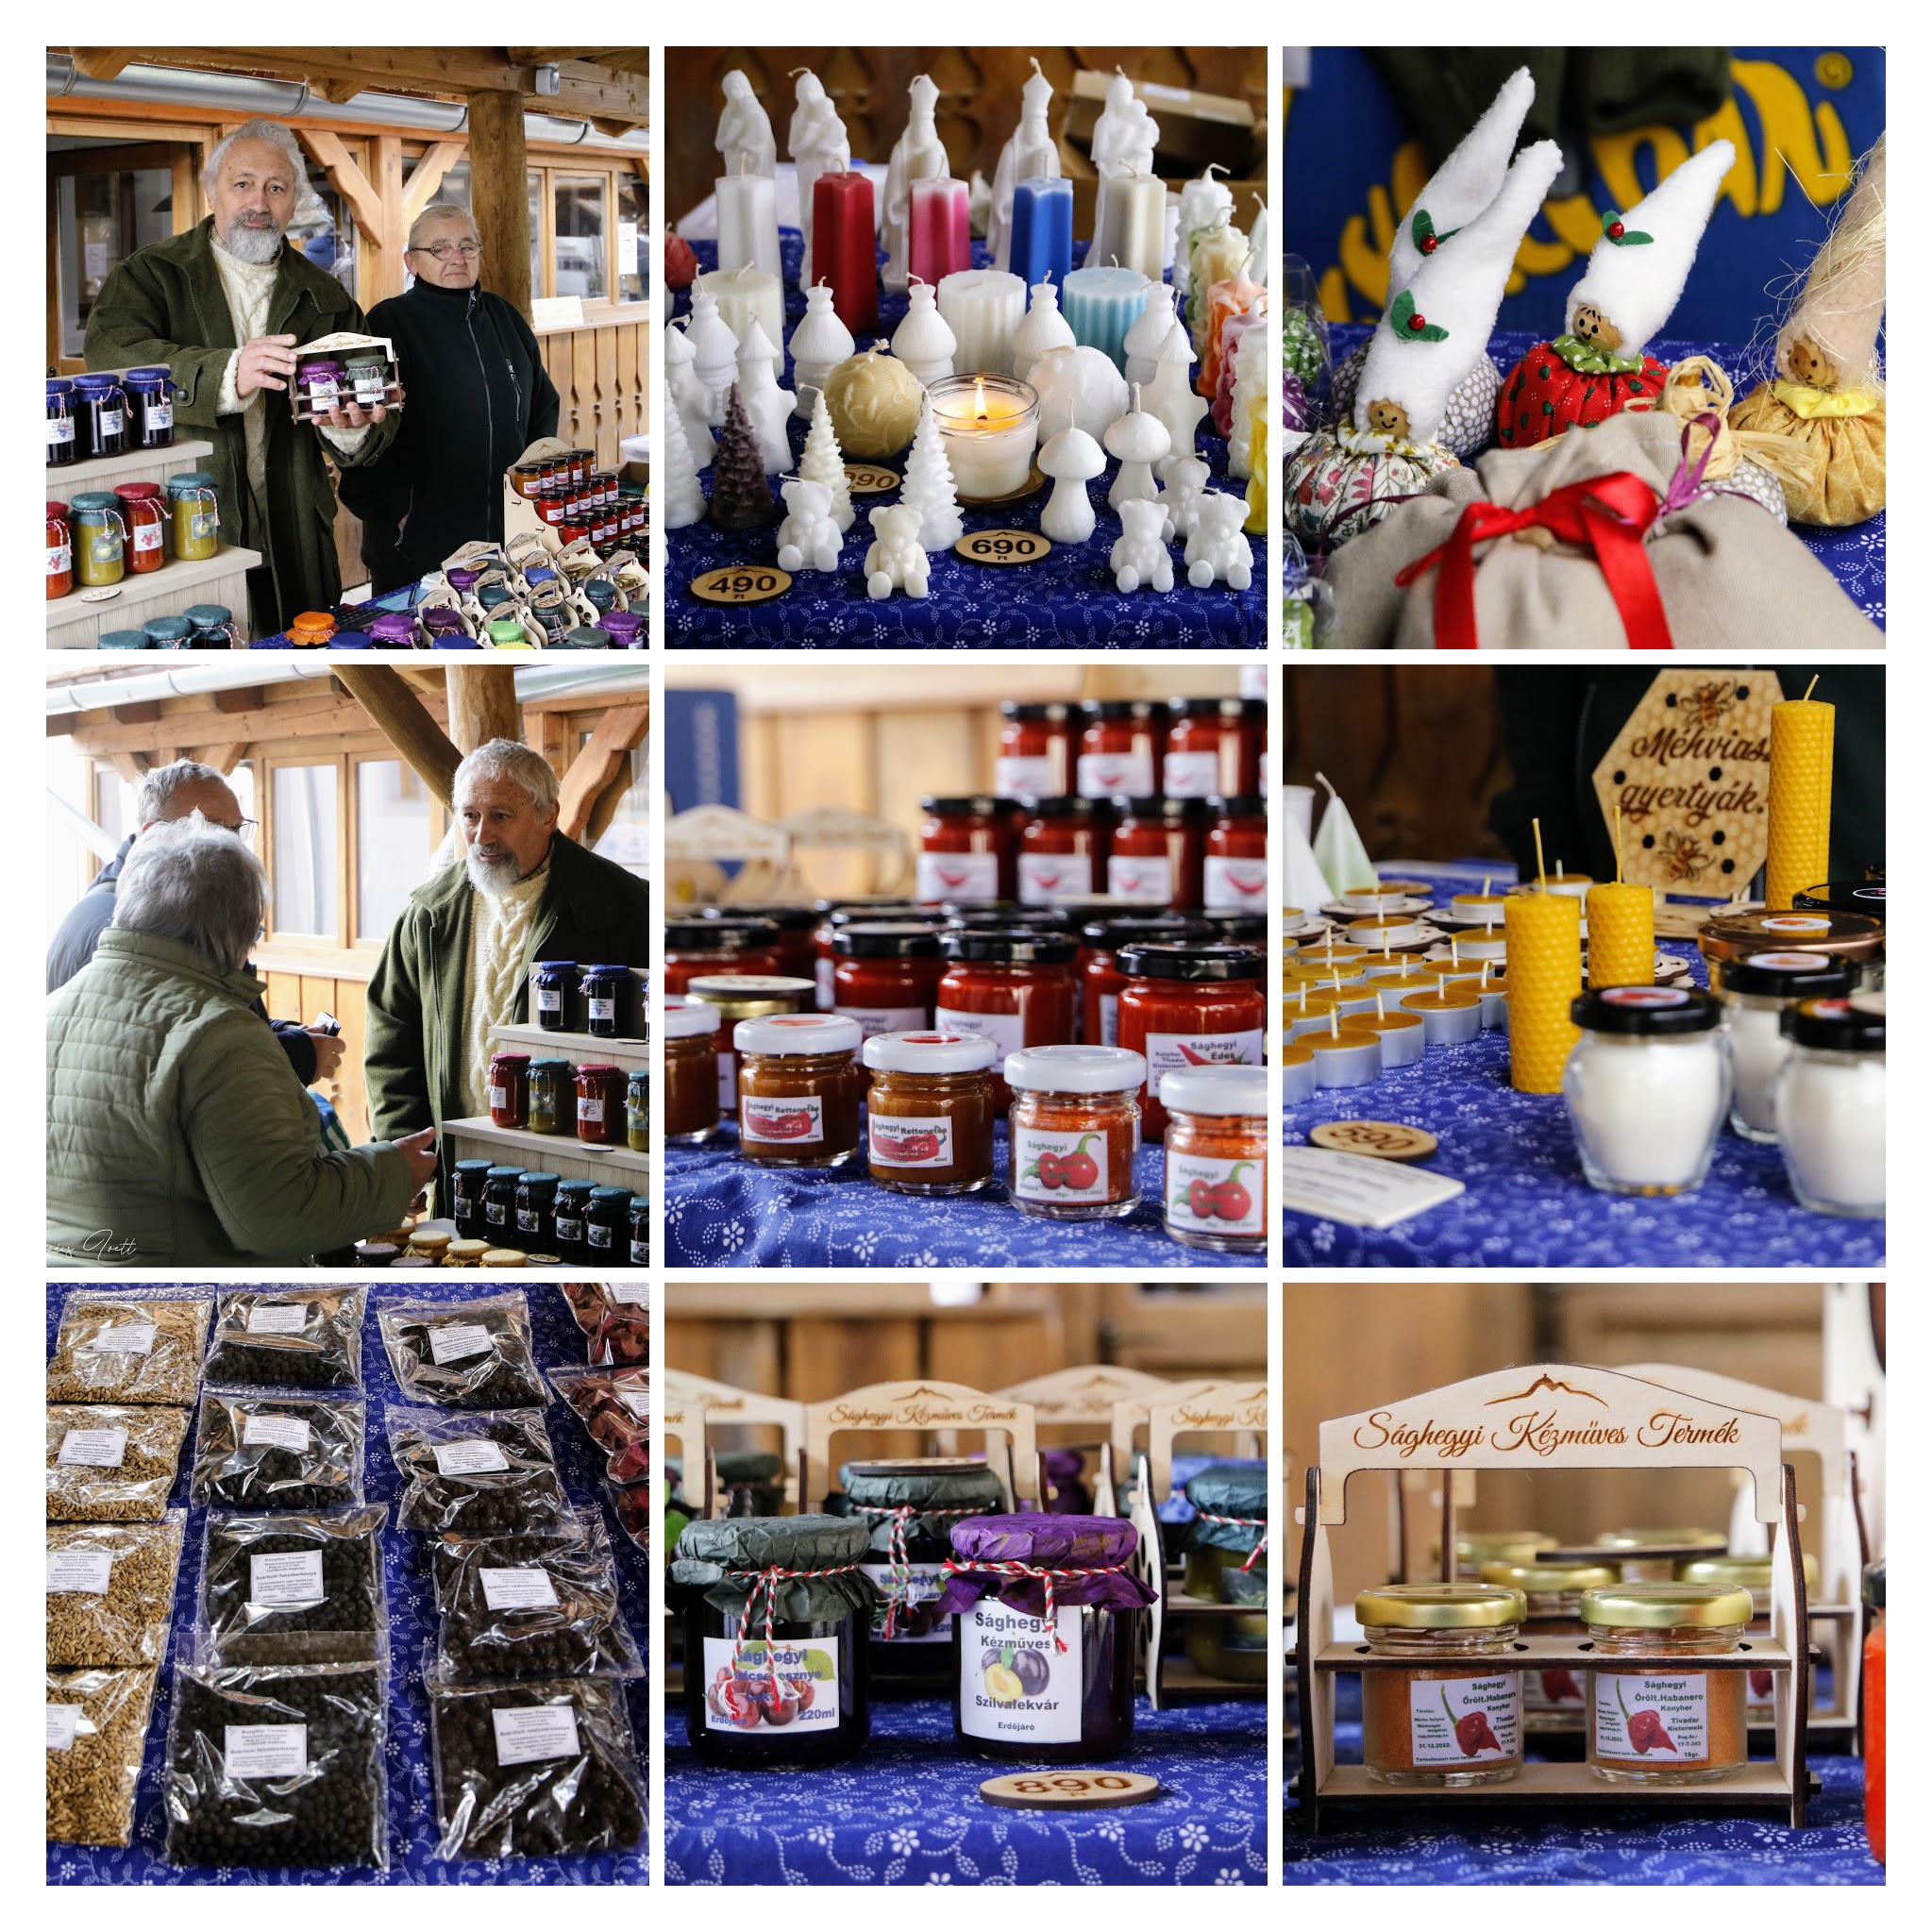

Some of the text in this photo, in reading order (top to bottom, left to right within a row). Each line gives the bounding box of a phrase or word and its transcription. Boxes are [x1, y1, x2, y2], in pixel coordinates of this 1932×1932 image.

[971, 538, 1036, 557] 690
[707, 575, 777, 594] 490
[1619, 780, 1765, 828] gyertyák.
[1190, 1039, 1237, 1051] Sághegyi
[1211, 1052, 1235, 1061] Édes
[1027, 1140, 1067, 1152] Sághegyi
[829, 1403, 893, 1427] Sághegyi
[968, 1403, 1018, 1423] Termék
[1353, 1411, 1485, 1458] Sághegyi
[1637, 1413, 1741, 1448] Termék
[975, 1611, 1058, 1634] Sághegyi
[981, 1635, 1050, 1650] Kézműves
[1471, 1679, 1506, 1691] Sághegyi
[1644, 1680, 1687, 1690] Sághegyi
[975, 1695, 1059, 1711] Szilvalekvár
[1635, 1692, 1704, 1703] Őrölt.Habanero
[798, 1707, 835, 1721] 220ml
[1487, 1703, 1511, 1712] Konyher
[1495, 1714, 1515, 1722] Tivadar
[1014, 1776, 1133, 1793] 890
